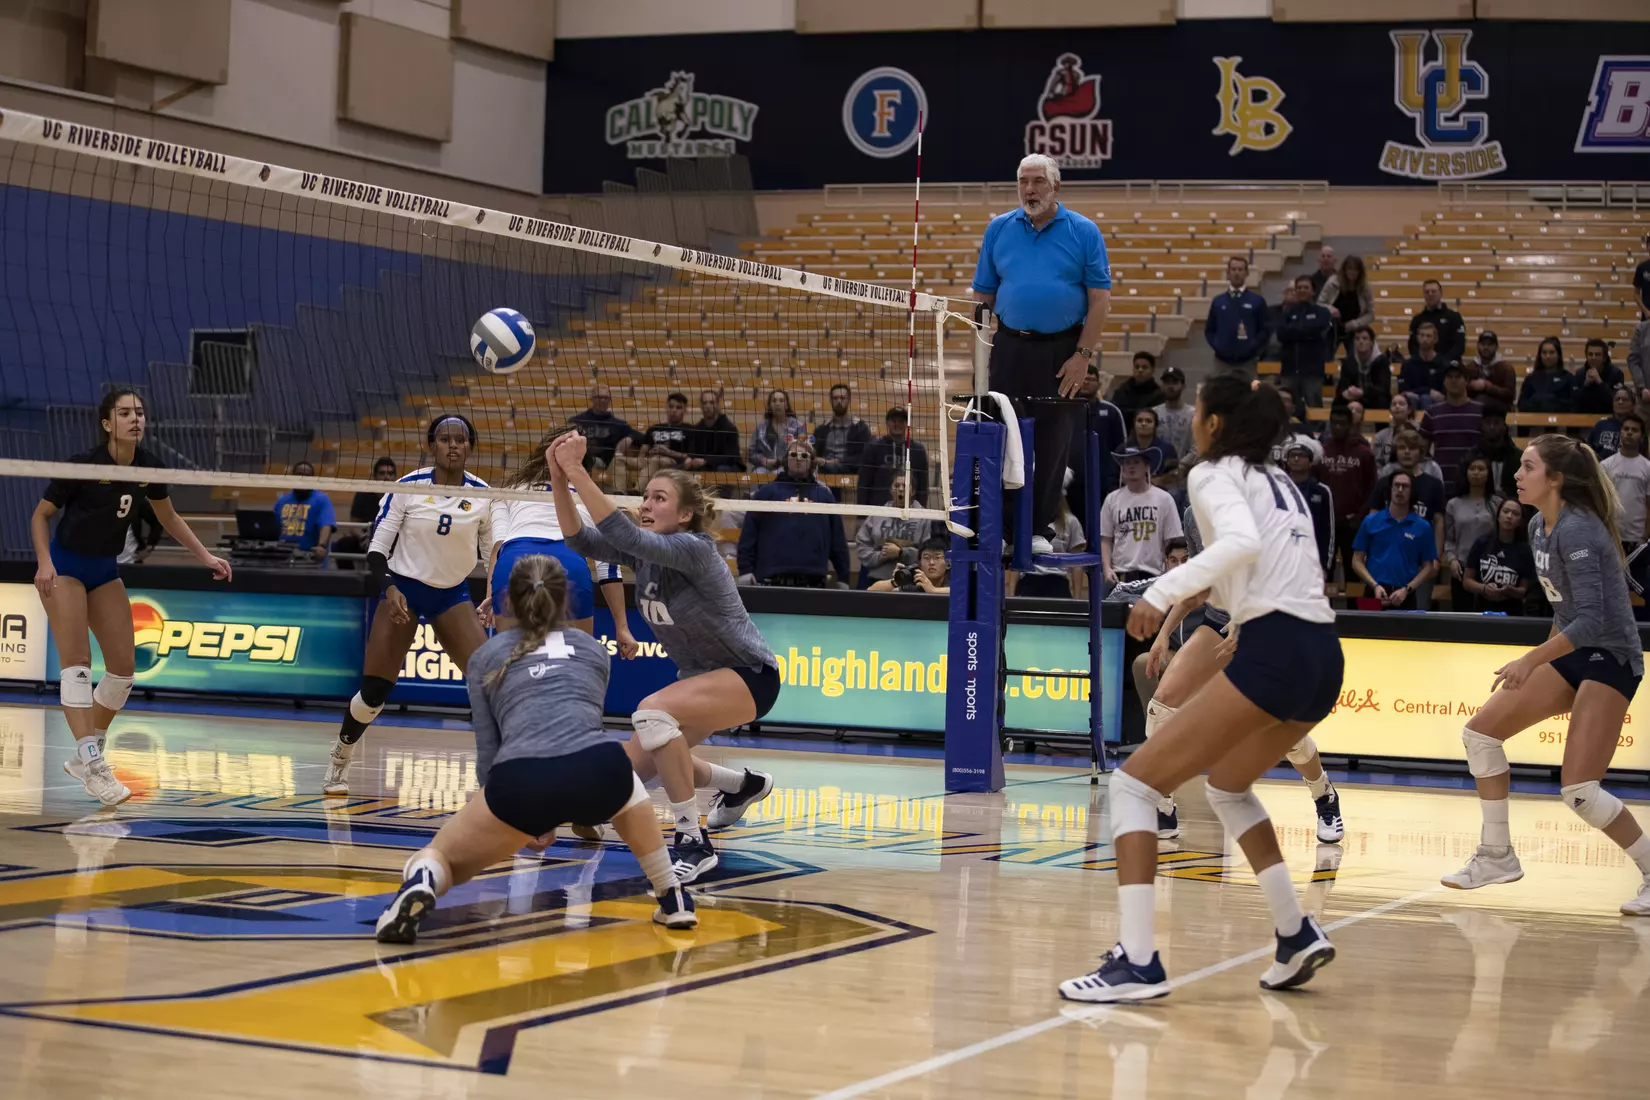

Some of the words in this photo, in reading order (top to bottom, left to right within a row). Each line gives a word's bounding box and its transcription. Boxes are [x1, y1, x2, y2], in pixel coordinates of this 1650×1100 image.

[1390, 30, 1488, 146] UC
[609, 97, 657, 139] CAL
[691, 96, 754, 138] POLY
[872, 89, 902, 137] F
[42, 119, 62, 141] UC
[67, 124, 143, 157] RIVERSIDE
[147, 140, 227, 174] VOLLEYBALL
[1027, 121, 1110, 157] CSUN
[1382, 145, 1503, 176] RIVERSIDE
[301, 172, 318, 191] UC
[321, 176, 383, 204] RIVERSIDE
[385, 189, 450, 218] VOLLEYBALL
[508, 215, 523, 233] UC
[525, 219, 577, 243] RIVERSIDE
[578, 228, 632, 253] VOLLEYBALL
[680, 248, 693, 263] UC
[695, 250, 736, 272] RIVERSIDE
[738, 259, 782, 281] VOLLEYBALL
[822, 276, 832, 290] UC
[834, 279, 868, 300] RIVERSIDE
[116, 494, 133, 519] 9
[436, 513, 453, 536] 8
[1132, 521, 1157, 542] UP
[639, 598, 675, 626] 10
[157, 620, 302, 662] PEPSI
[409, 623, 444, 652] BU
[527, 630, 576, 660] 4
[965, 631, 979, 671] sports
[398, 650, 463, 681] IGH
[1393, 698, 1453, 716] Central
